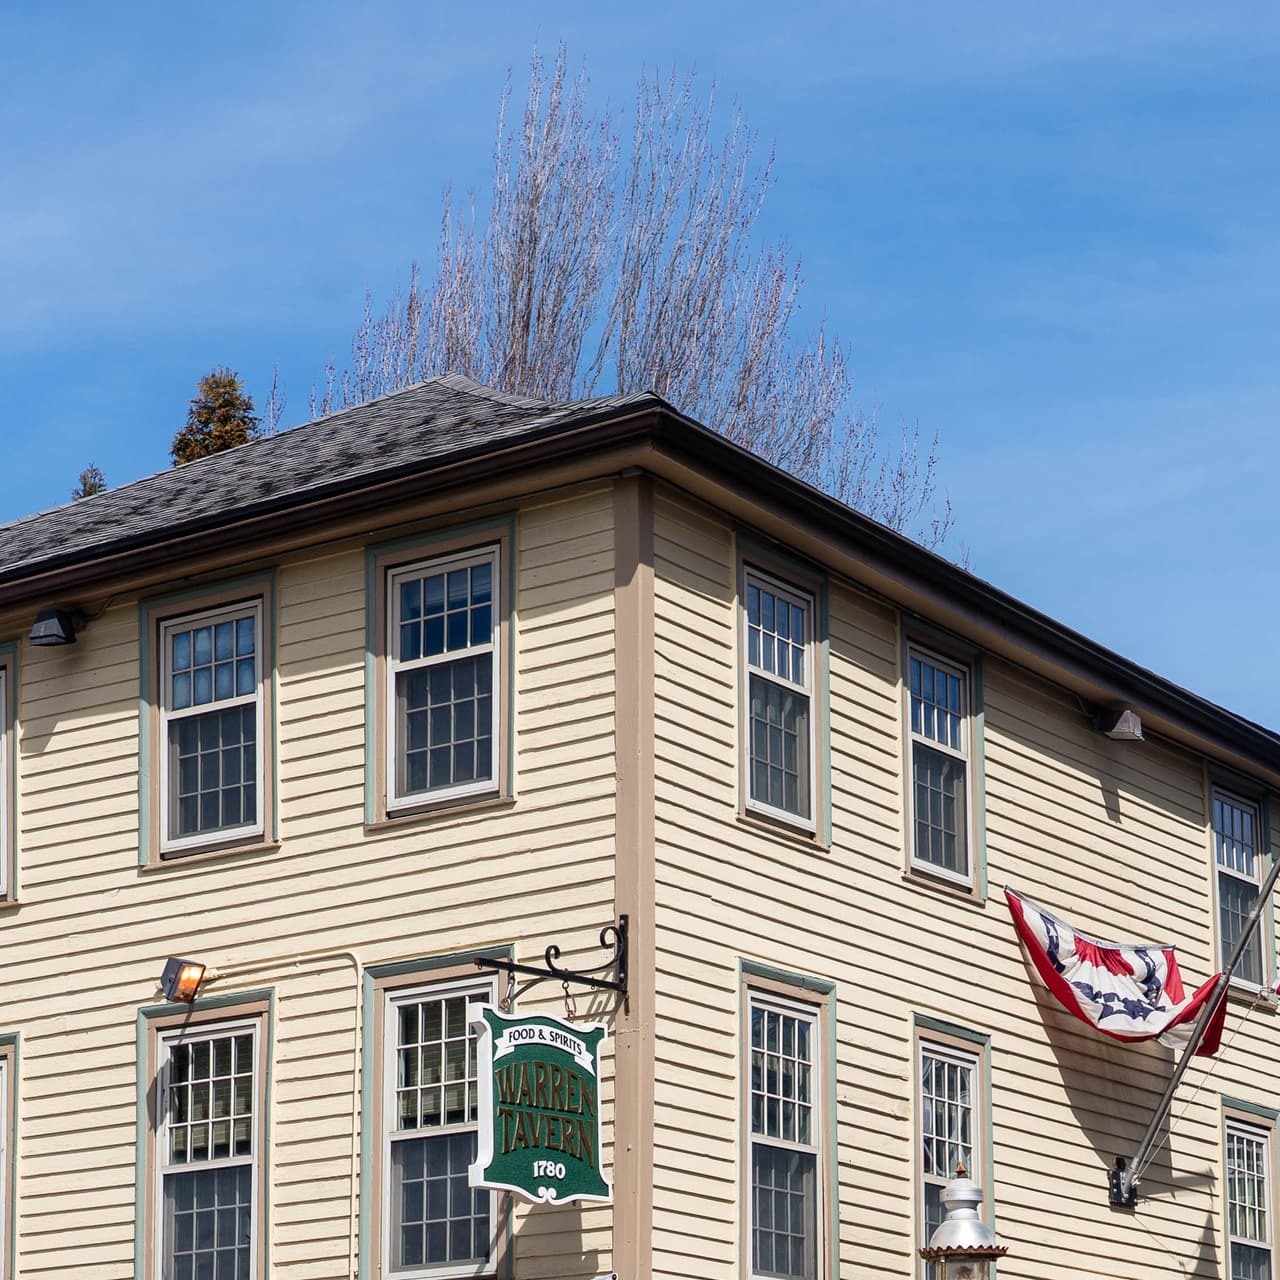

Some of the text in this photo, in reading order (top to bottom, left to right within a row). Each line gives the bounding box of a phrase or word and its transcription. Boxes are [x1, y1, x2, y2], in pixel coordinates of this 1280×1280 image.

[508, 1028, 583, 1055] FOOD & SPIRITS
[495, 1060, 595, 1117] WARREN
[497, 1106, 594, 1168] TAVERN
[532, 1160, 566, 1179] 1780
